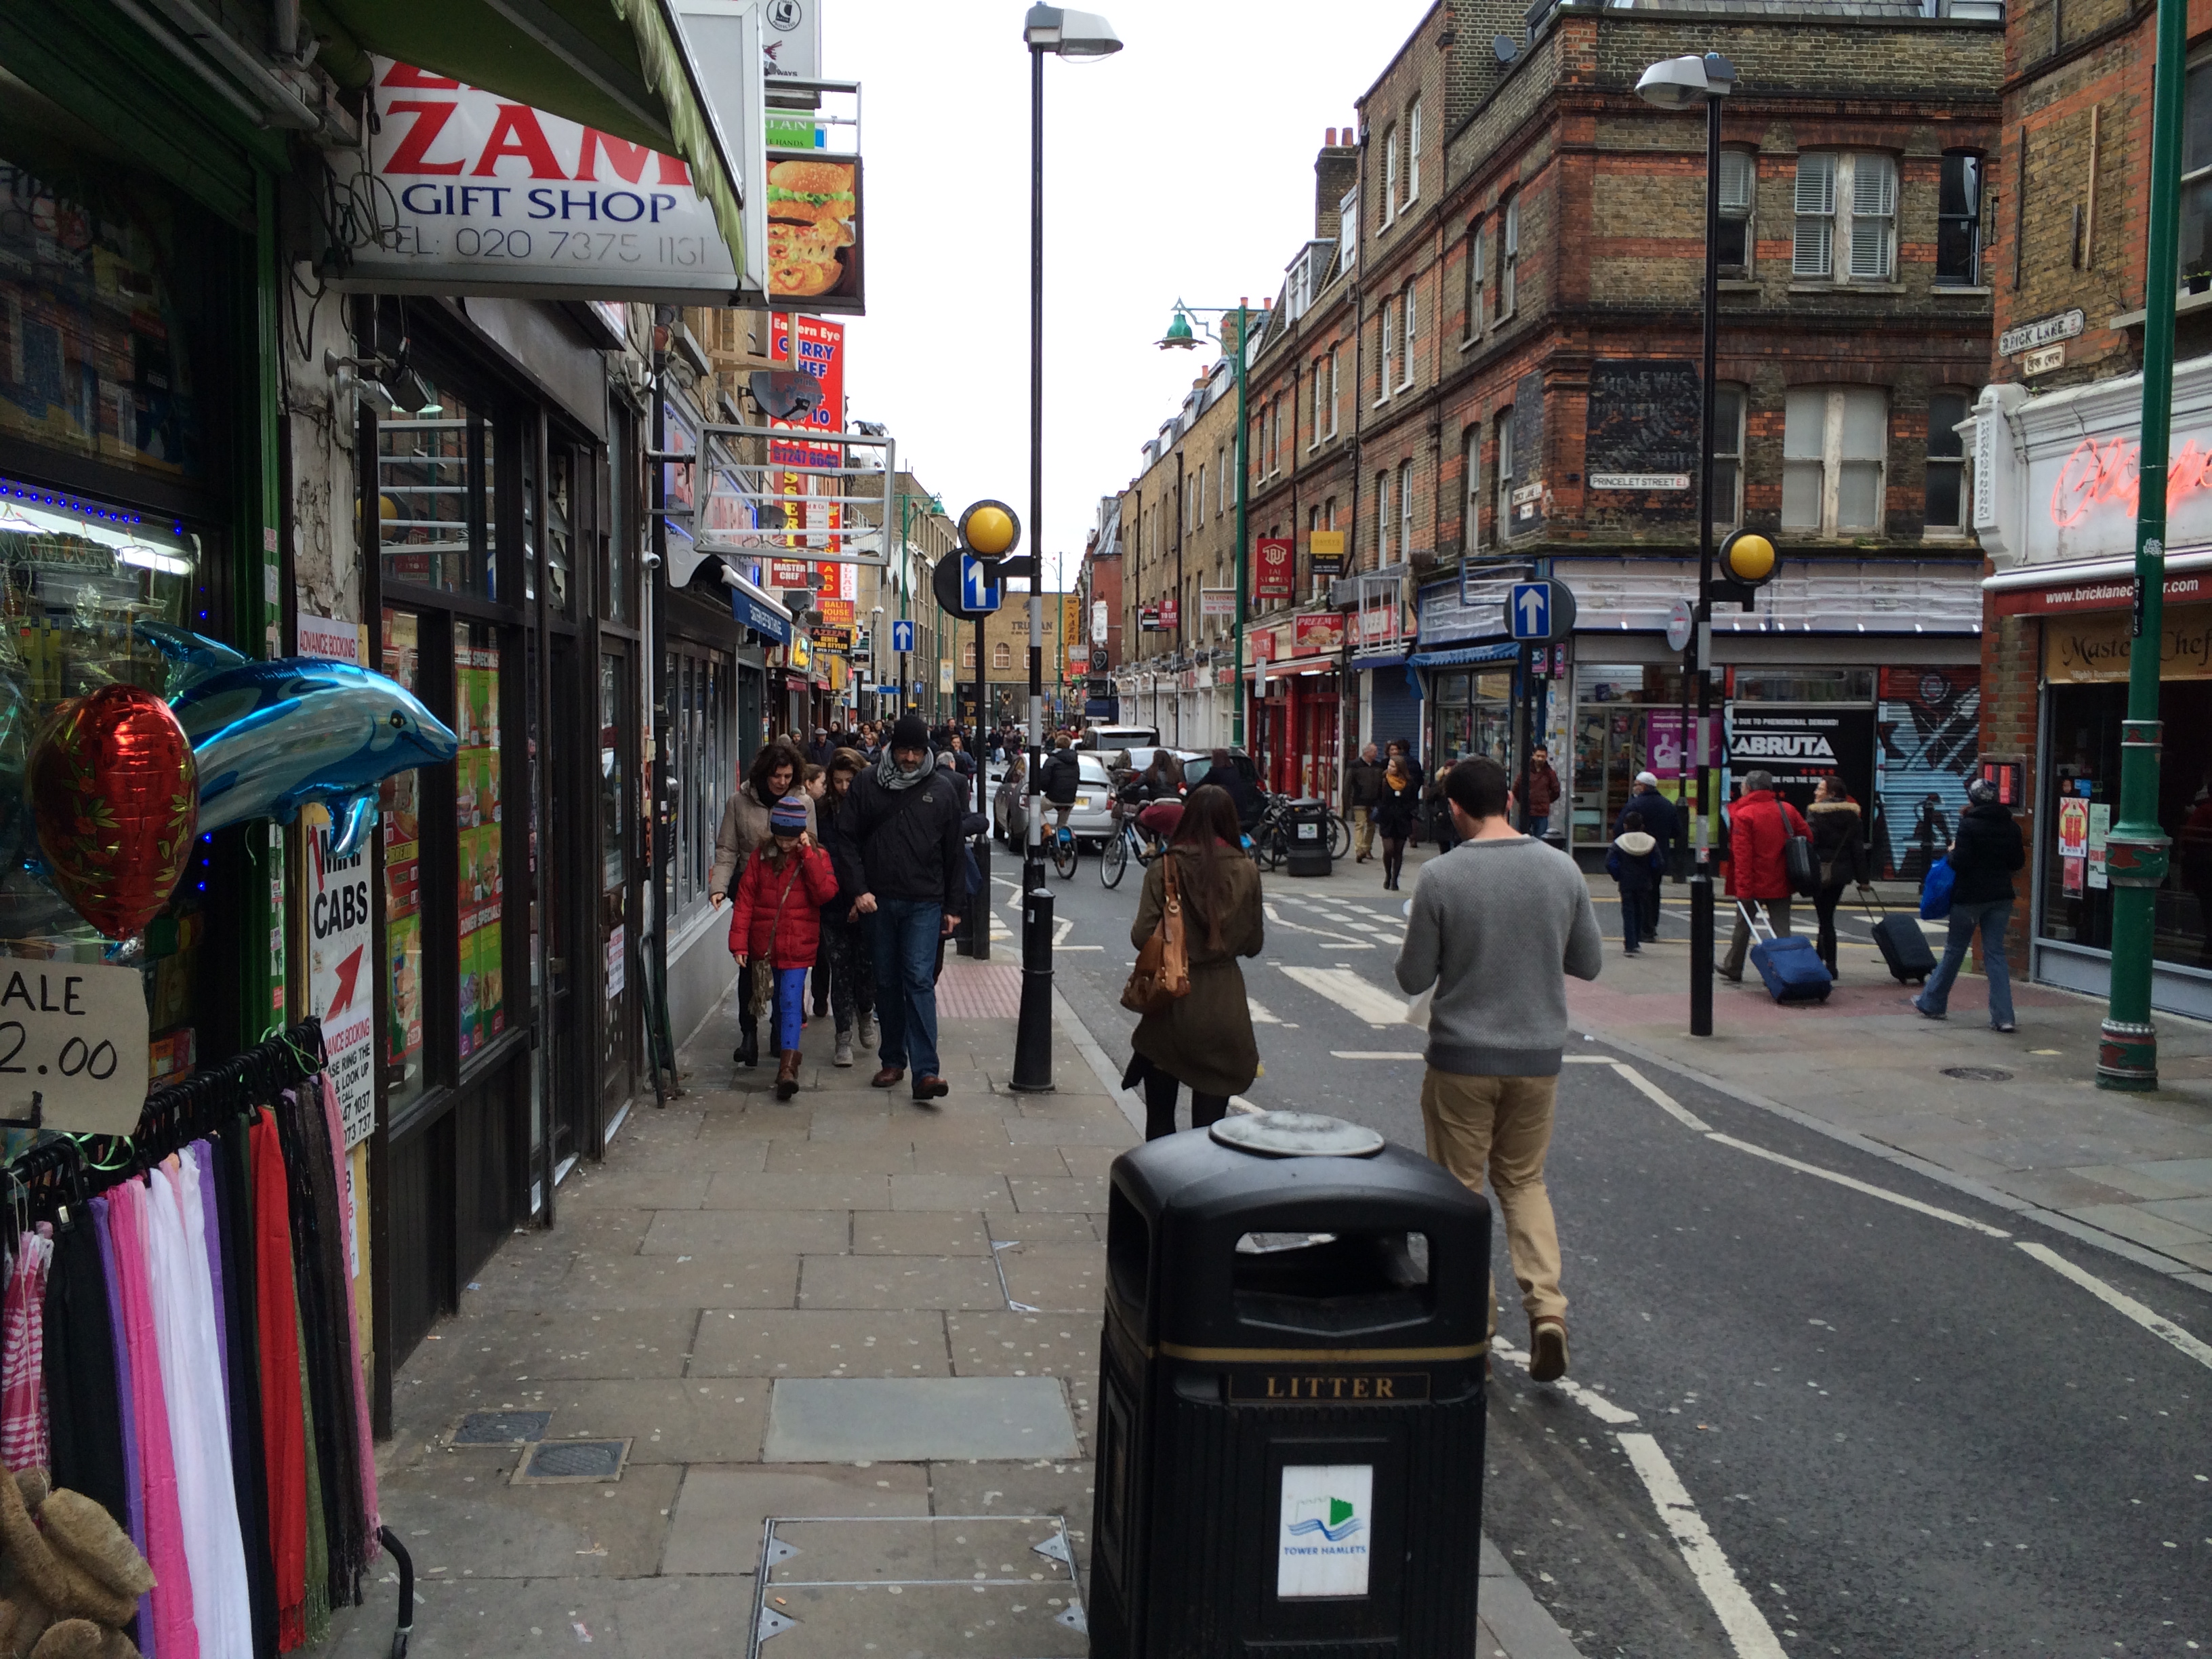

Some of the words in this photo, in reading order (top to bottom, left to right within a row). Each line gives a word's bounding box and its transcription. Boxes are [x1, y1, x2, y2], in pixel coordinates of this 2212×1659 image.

[382, 100, 693, 186] ZAM
[776, 138, 804, 146] HANDS
[402, 184, 511, 217] GIFT
[527, 188, 677, 223] SHOP
[456, 228, 531, 258] 020
[548, 231, 642, 262] 7375
[774, 317, 817, 337] Eaern
[820, 327, 841, 342] Eye
[778, 335, 836, 361] CRRY
[1593, 477, 1640, 486] PRINCELET
[1641, 477, 1675, 486] STREET
[774, 563, 806, 572] MASTER
[779, 572, 800, 581] CHEF
[825, 600, 847, 609] BALTI
[1011, 621, 1053, 630] TRUAN
[1298, 617, 1332, 626] PREEM
[300, 629, 328, 655] ADVANCE
[329, 634, 355, 659] BOOKING
[2062, 636, 2131, 666] Maste
[314, 880, 368, 940] CABS
[1, 970, 86, 1015] ALE
[345, 1017, 370, 1049] BOOKING
[0, 1021, 118, 1080] 2.00
[327, 1061, 340, 1079] ASE
[342, 1051, 357, 1072] RING
[358, 1042, 371, 1061] THE
[335, 1080, 340, 1094] &
[342, 1070, 360, 1090] LOOK
[361, 1061, 369, 1080] UP
[342, 1088, 354, 1105] CALL
[342, 1103, 352, 1123] 47
[354, 1090, 371, 1115] 1037
[359, 1112, 371, 1133] 737
[1267, 1377, 1395, 1398] LITTER
[1284, 1547, 1318, 1555] TOWER
[1321, 1546, 1367, 1555] HAMLETS
